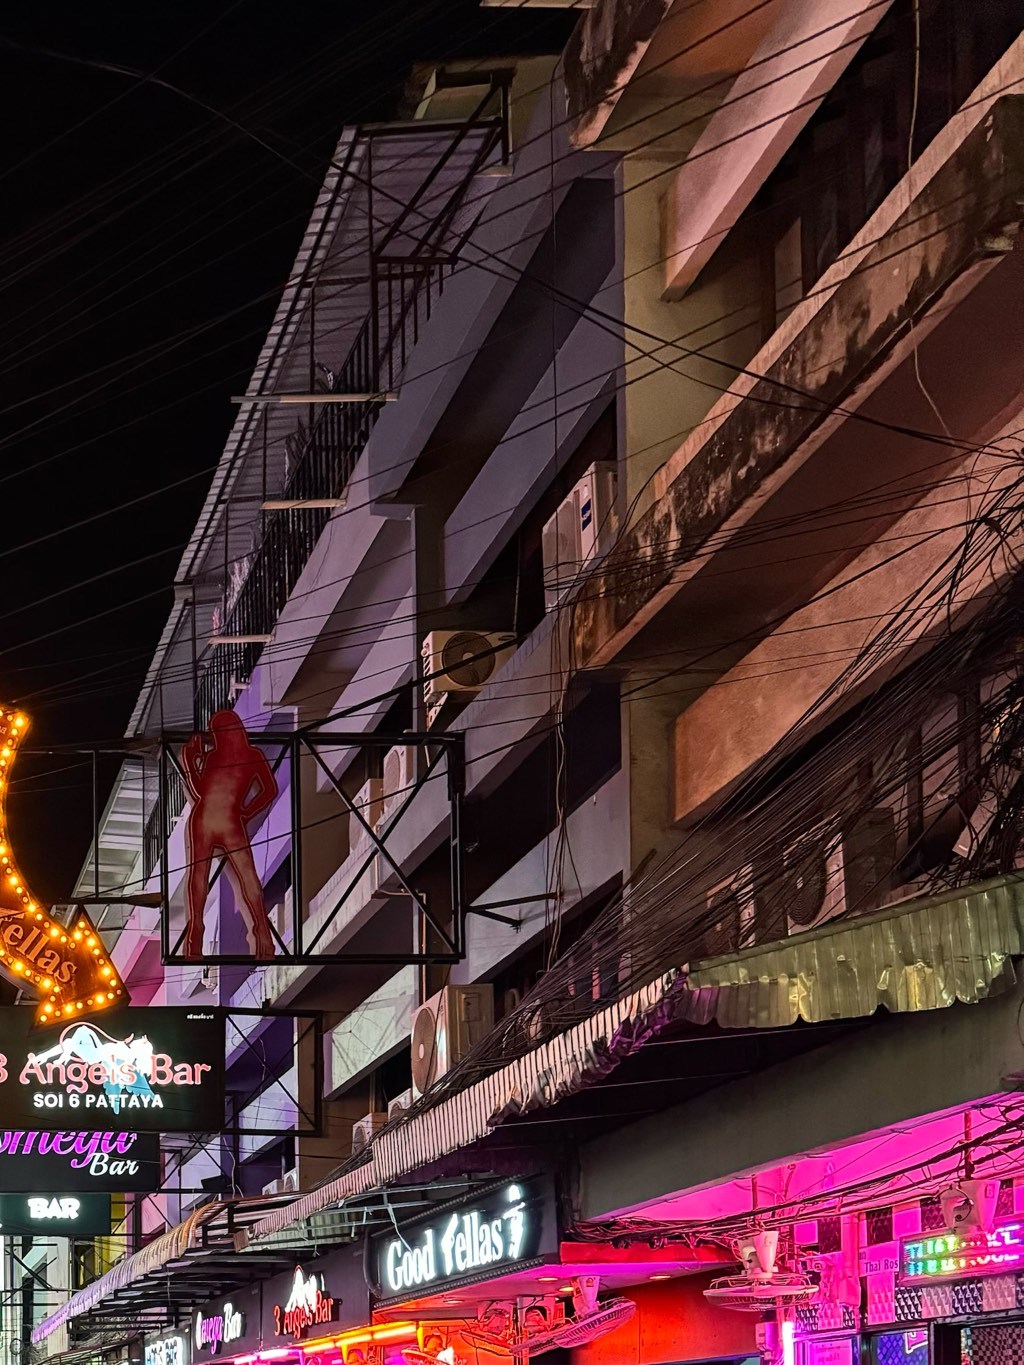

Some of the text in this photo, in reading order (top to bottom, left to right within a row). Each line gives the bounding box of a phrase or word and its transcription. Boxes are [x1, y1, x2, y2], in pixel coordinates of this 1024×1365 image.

[20, 1053, 136, 1093] Angels
[149, 1054, 211, 1085] Bar
[33, 1093, 164, 1108] SOI 6 PATTAYA
[89, 1152, 139, 1176] Bar
[27, 1197, 81, 1220] BAR
[387, 1227, 436, 1291] Good
[273, 1305, 281, 1337] 3
[315, 1289, 333, 1325] Bar
